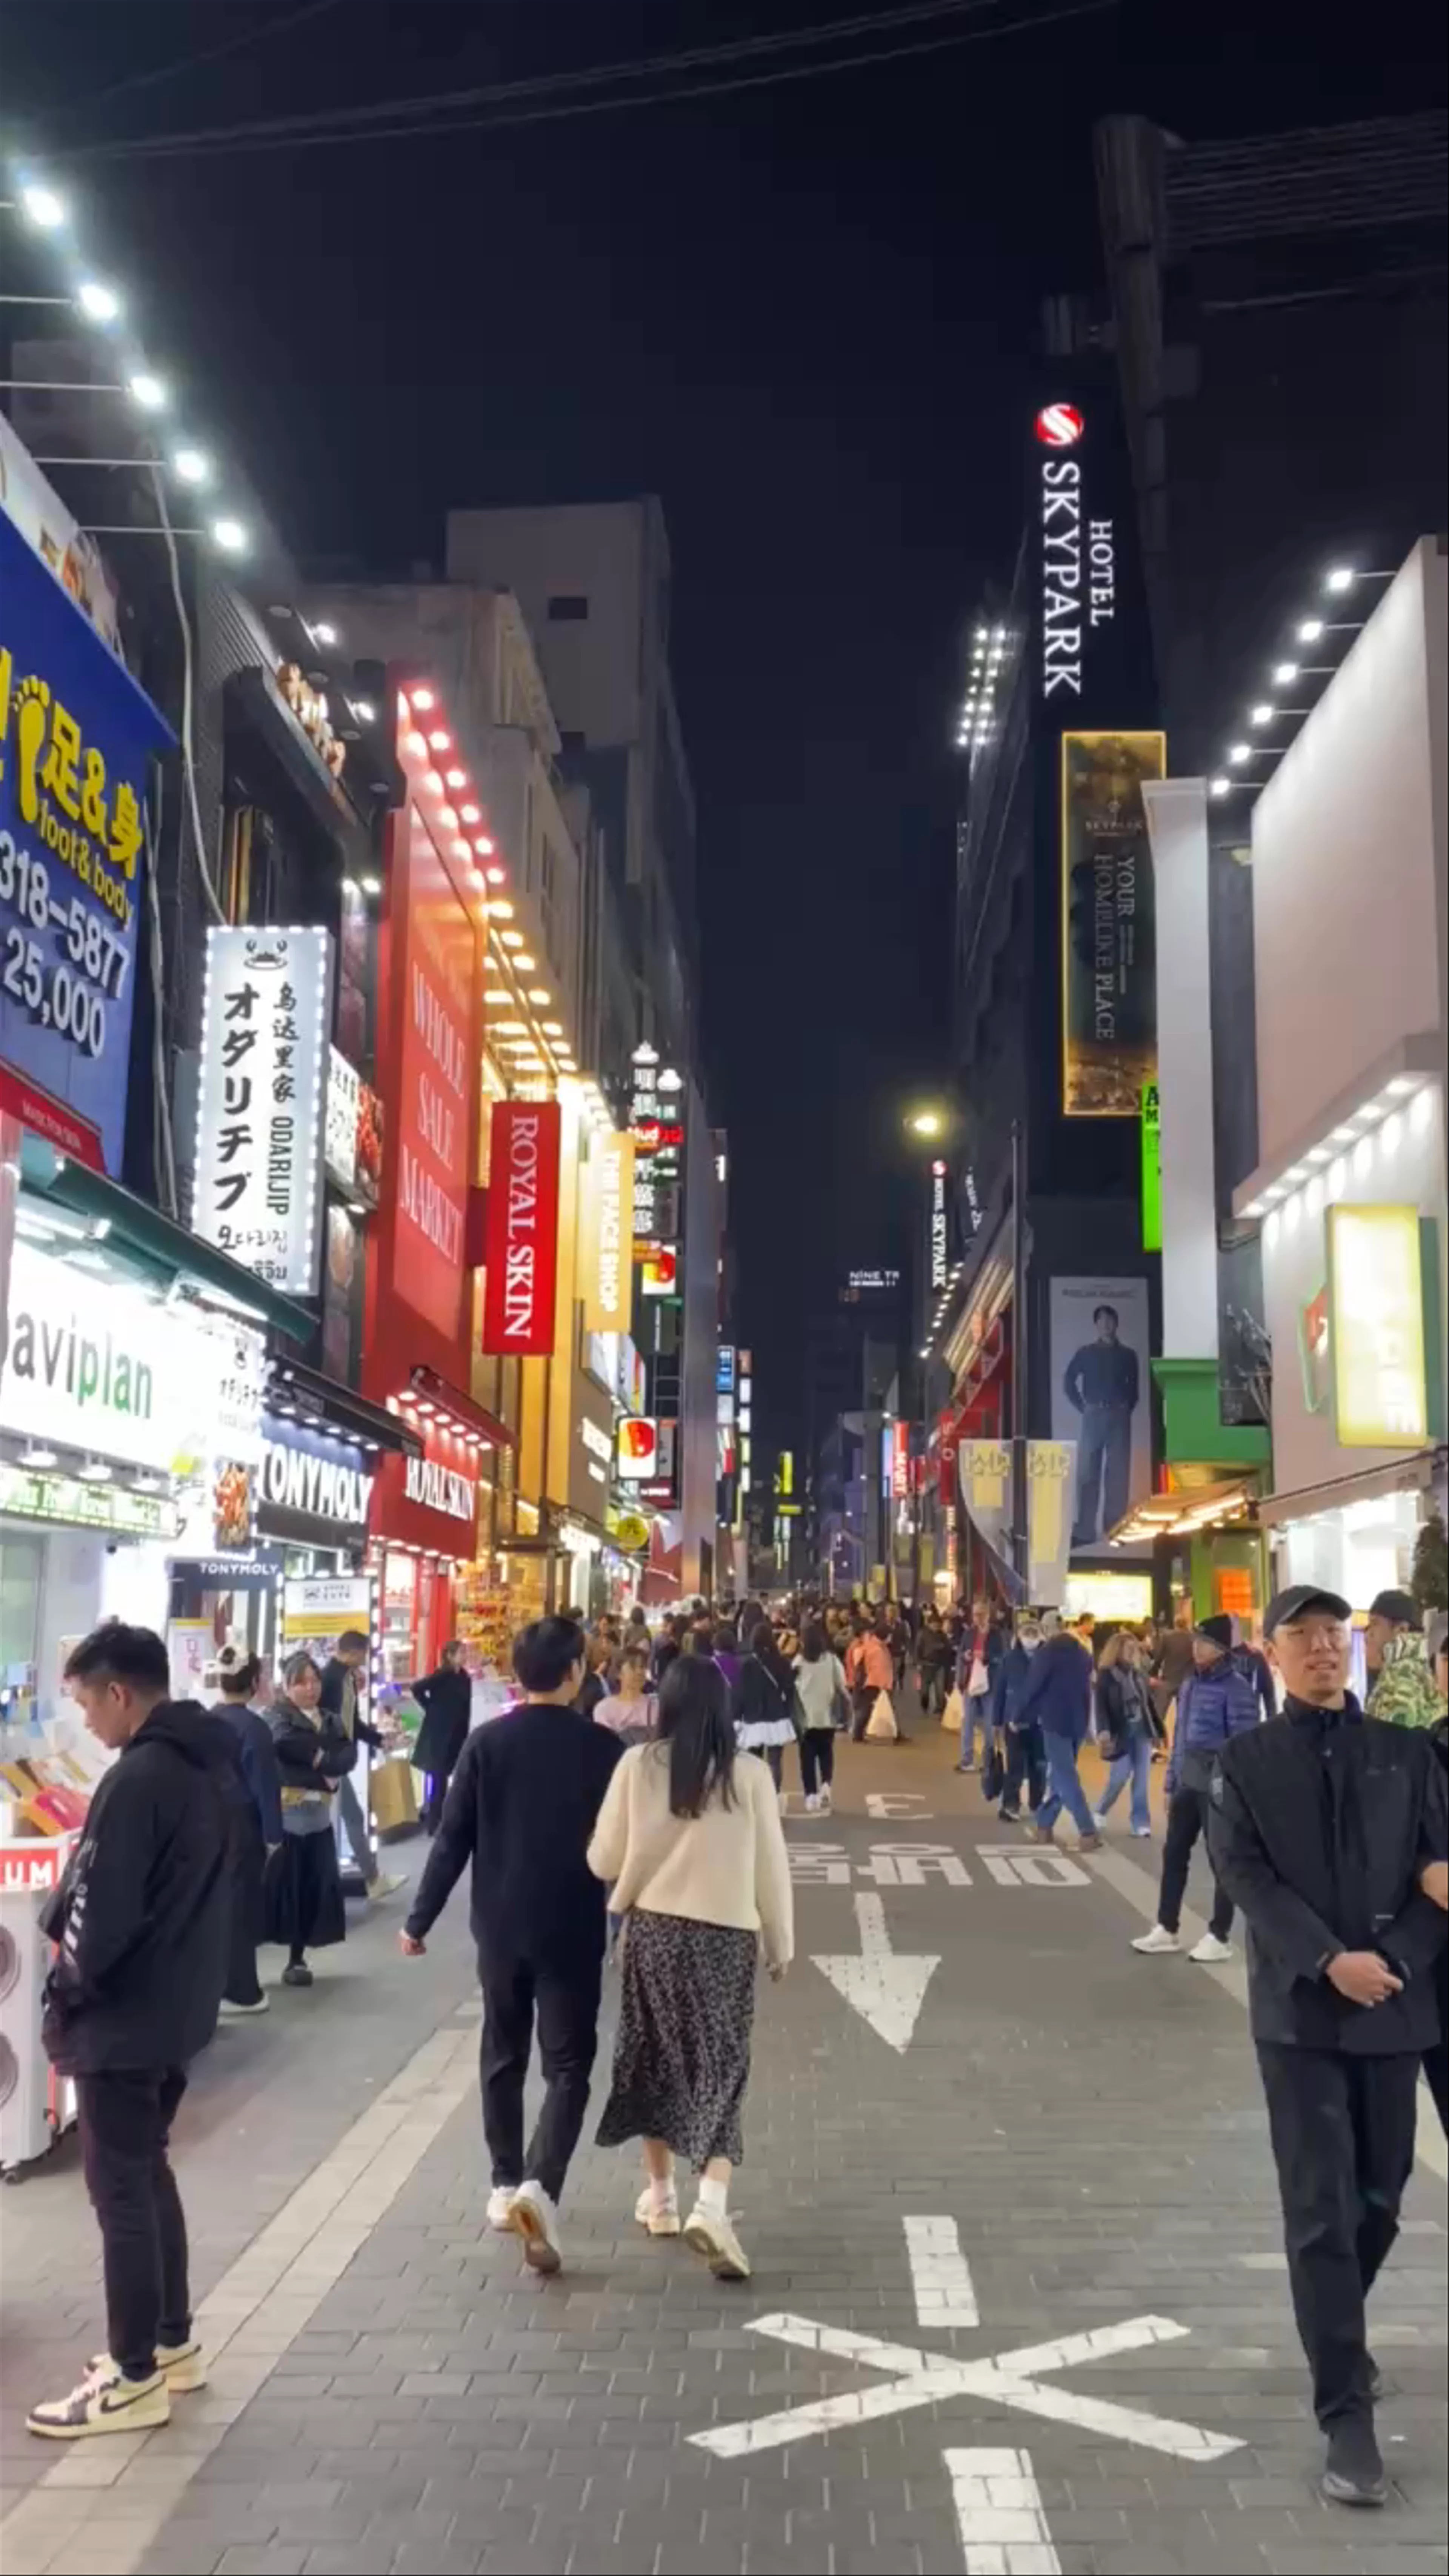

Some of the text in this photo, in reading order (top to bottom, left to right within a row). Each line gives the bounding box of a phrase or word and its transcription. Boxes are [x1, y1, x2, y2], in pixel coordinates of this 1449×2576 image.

[1042, 461, 1081, 698] SKYPARK
[1089, 520, 1114, 626] HOTEL
[1094, 854, 1114, 968] HOMELIKE
[1117, 856, 1135, 917] YOUR
[4, 926, 105, 1058] 25,000
[412, 960, 466, 1100] WHOLE
[1095, 973, 1115, 1040] PLACE
[266, 1115, 295, 1216] ODARIJIP
[417, 1072, 454, 1172] SALE
[400, 1143, 464, 1267] MARKET
[503, 1114, 539, 1340] ROYAL SKIN
[932, 1214, 946, 1288] SKYPARK
[598, 1253, 620, 1312] SHOP
[849, 1271, 880, 1280] NINE
[254, 1438, 374, 1525] TONYMOLY
[199, 1561, 279, 1575] TONYMOLY
